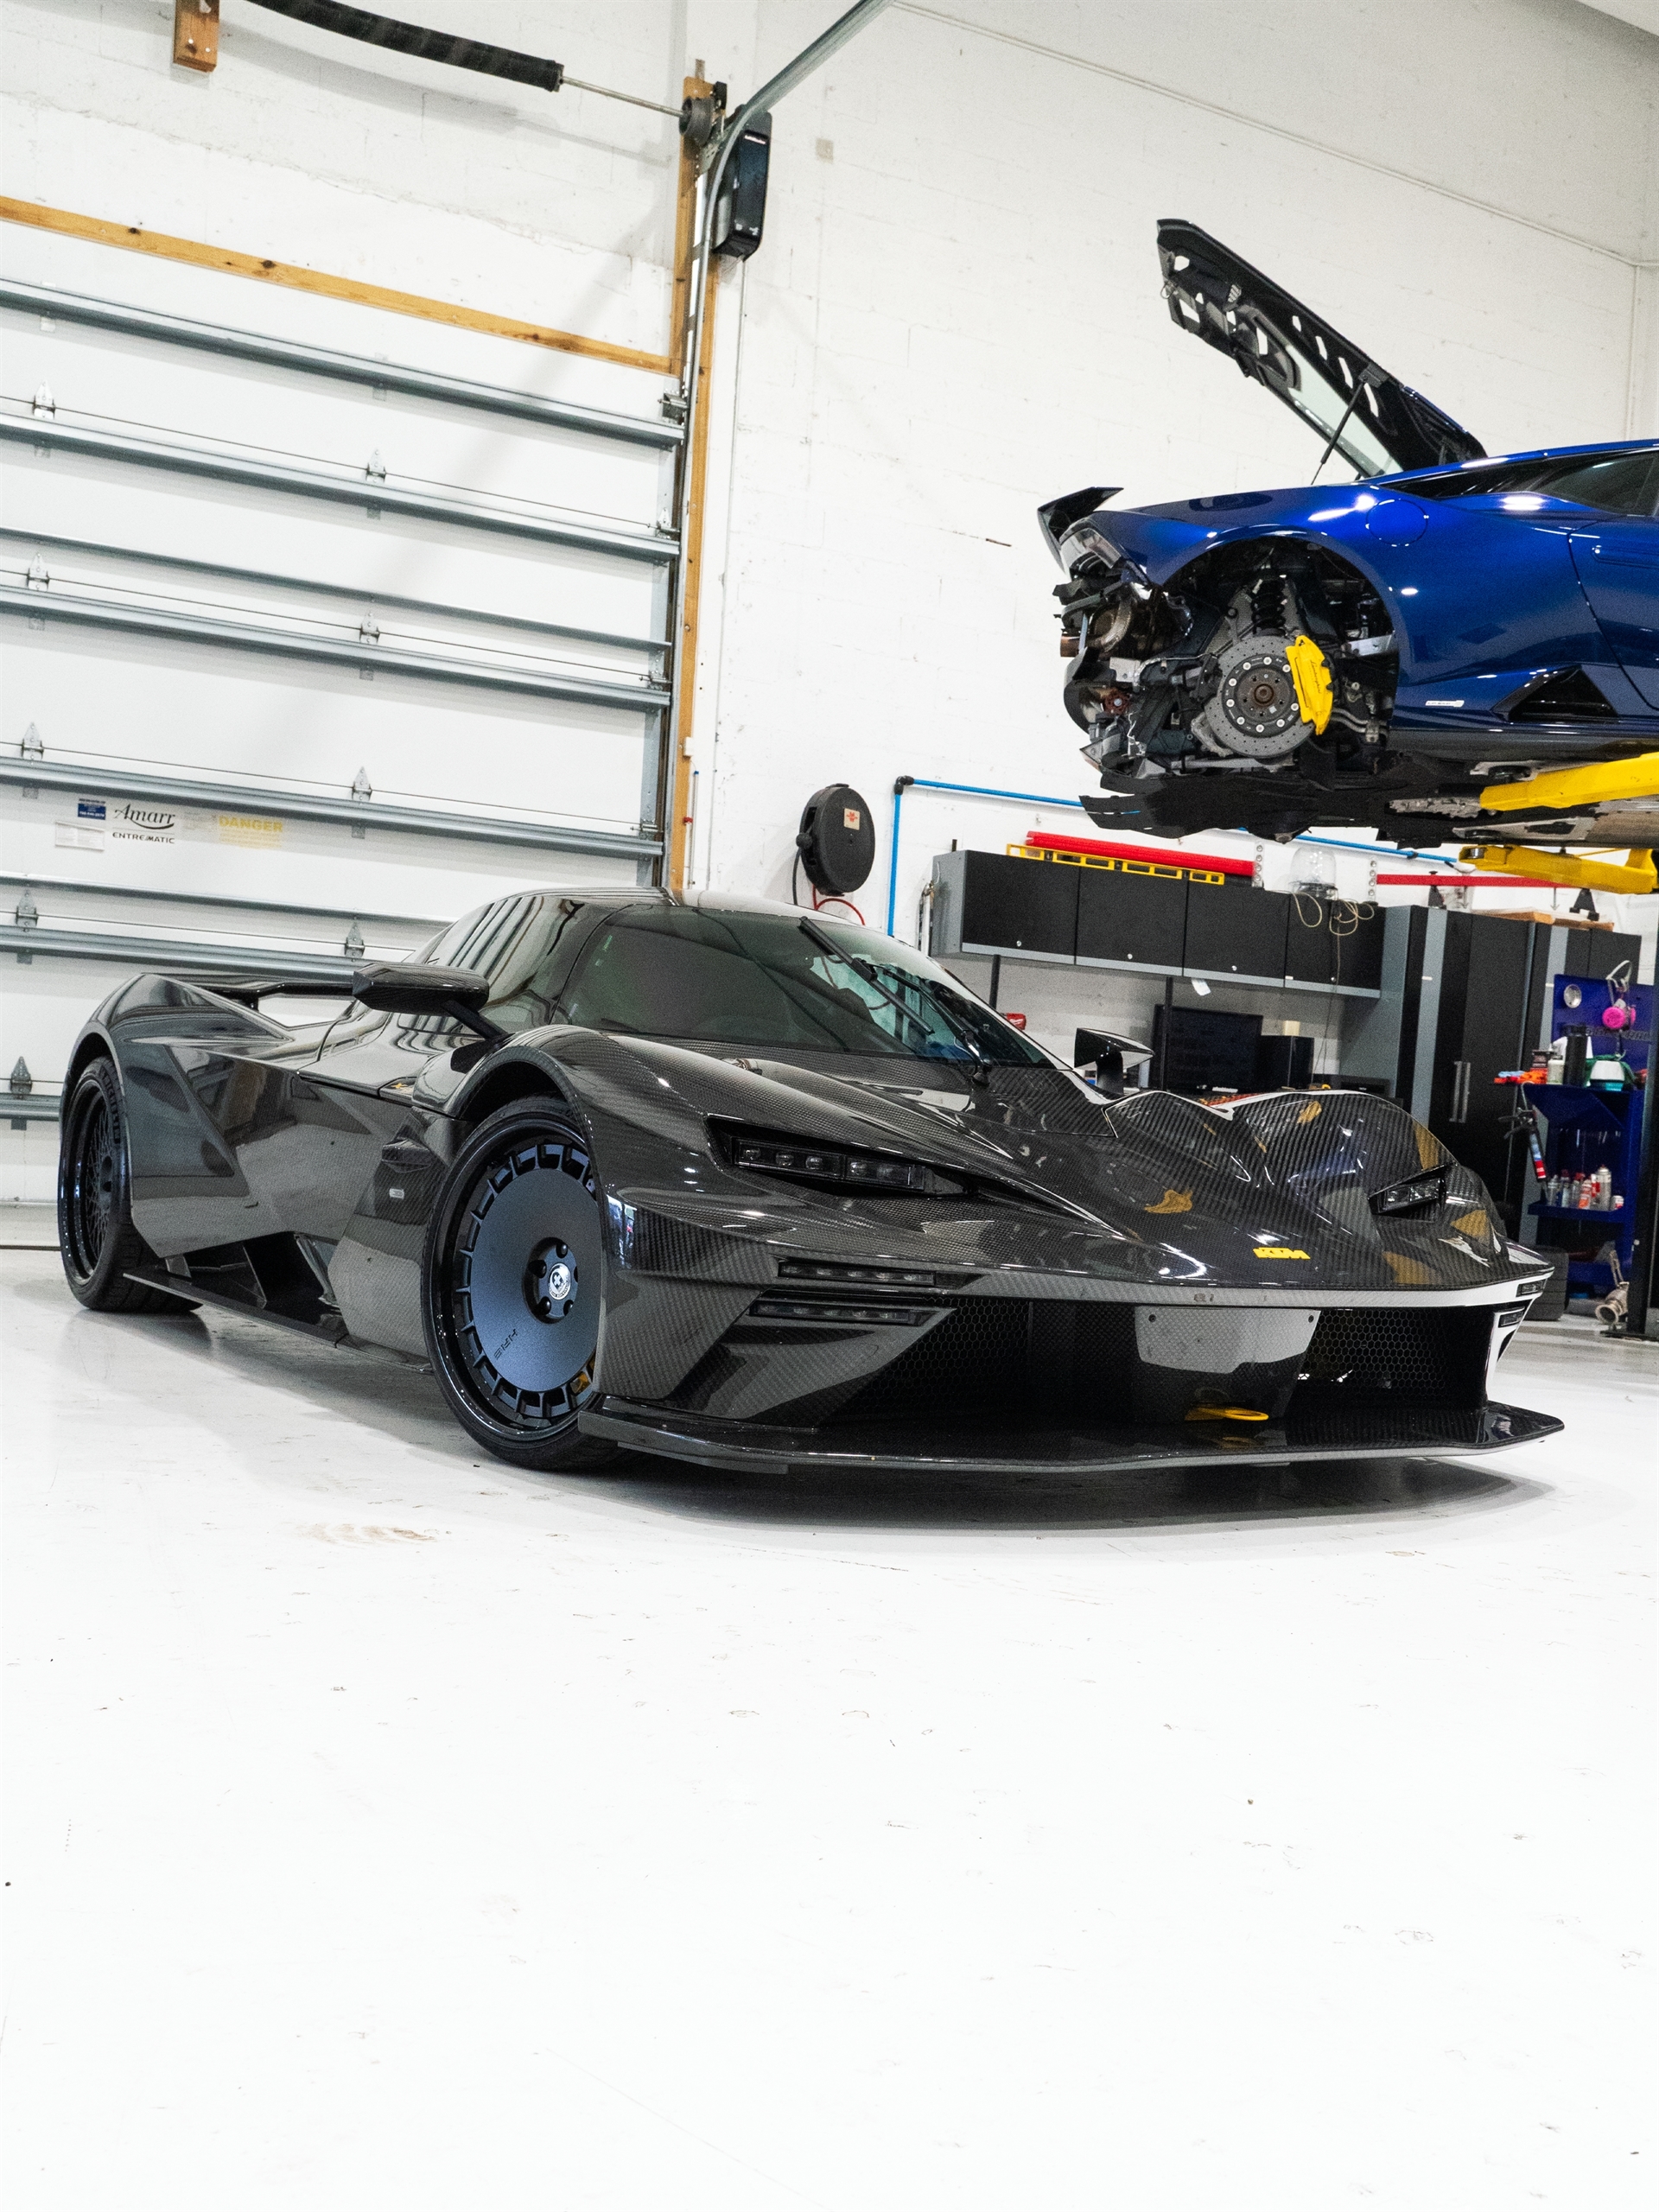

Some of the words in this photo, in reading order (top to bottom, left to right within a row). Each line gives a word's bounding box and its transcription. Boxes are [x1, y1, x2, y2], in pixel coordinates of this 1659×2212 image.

[114, 804, 175, 828] Amarr
[219, 815, 283, 832] DANGER
[1252, 1247, 1311, 1259] KTM
